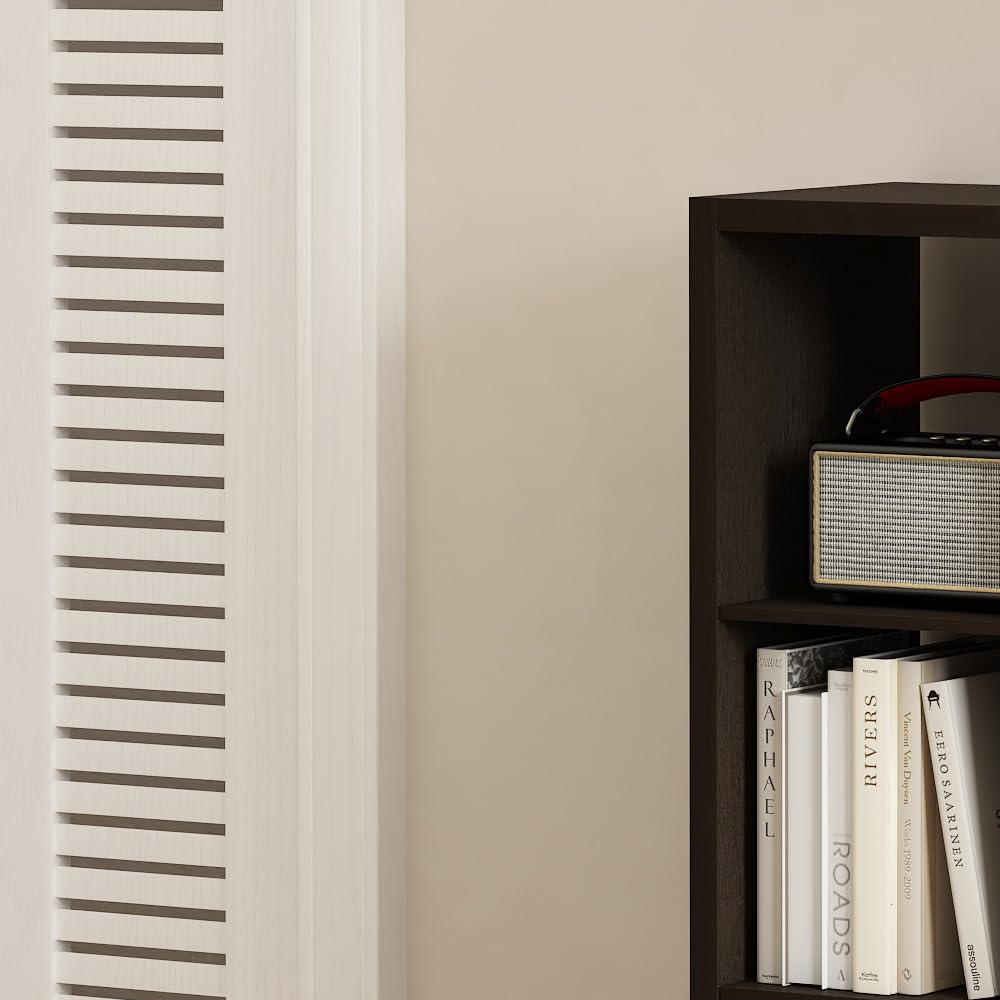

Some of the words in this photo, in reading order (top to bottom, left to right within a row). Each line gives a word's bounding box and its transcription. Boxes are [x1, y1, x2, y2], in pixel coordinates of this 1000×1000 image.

[864, 695, 877, 787] RIVERS
[903, 711, 912, 747] Vincent
[934, 730, 949, 774] EERO
[763, 680, 777, 838] RAPHAEL
[903, 748, 912, 768] Van
[902, 770, 912, 805] Duysen
[941, 780, 964, 868] SAARINEN
[832, 841, 850, 956] ROADS
[967, 944, 982, 992] assouline
